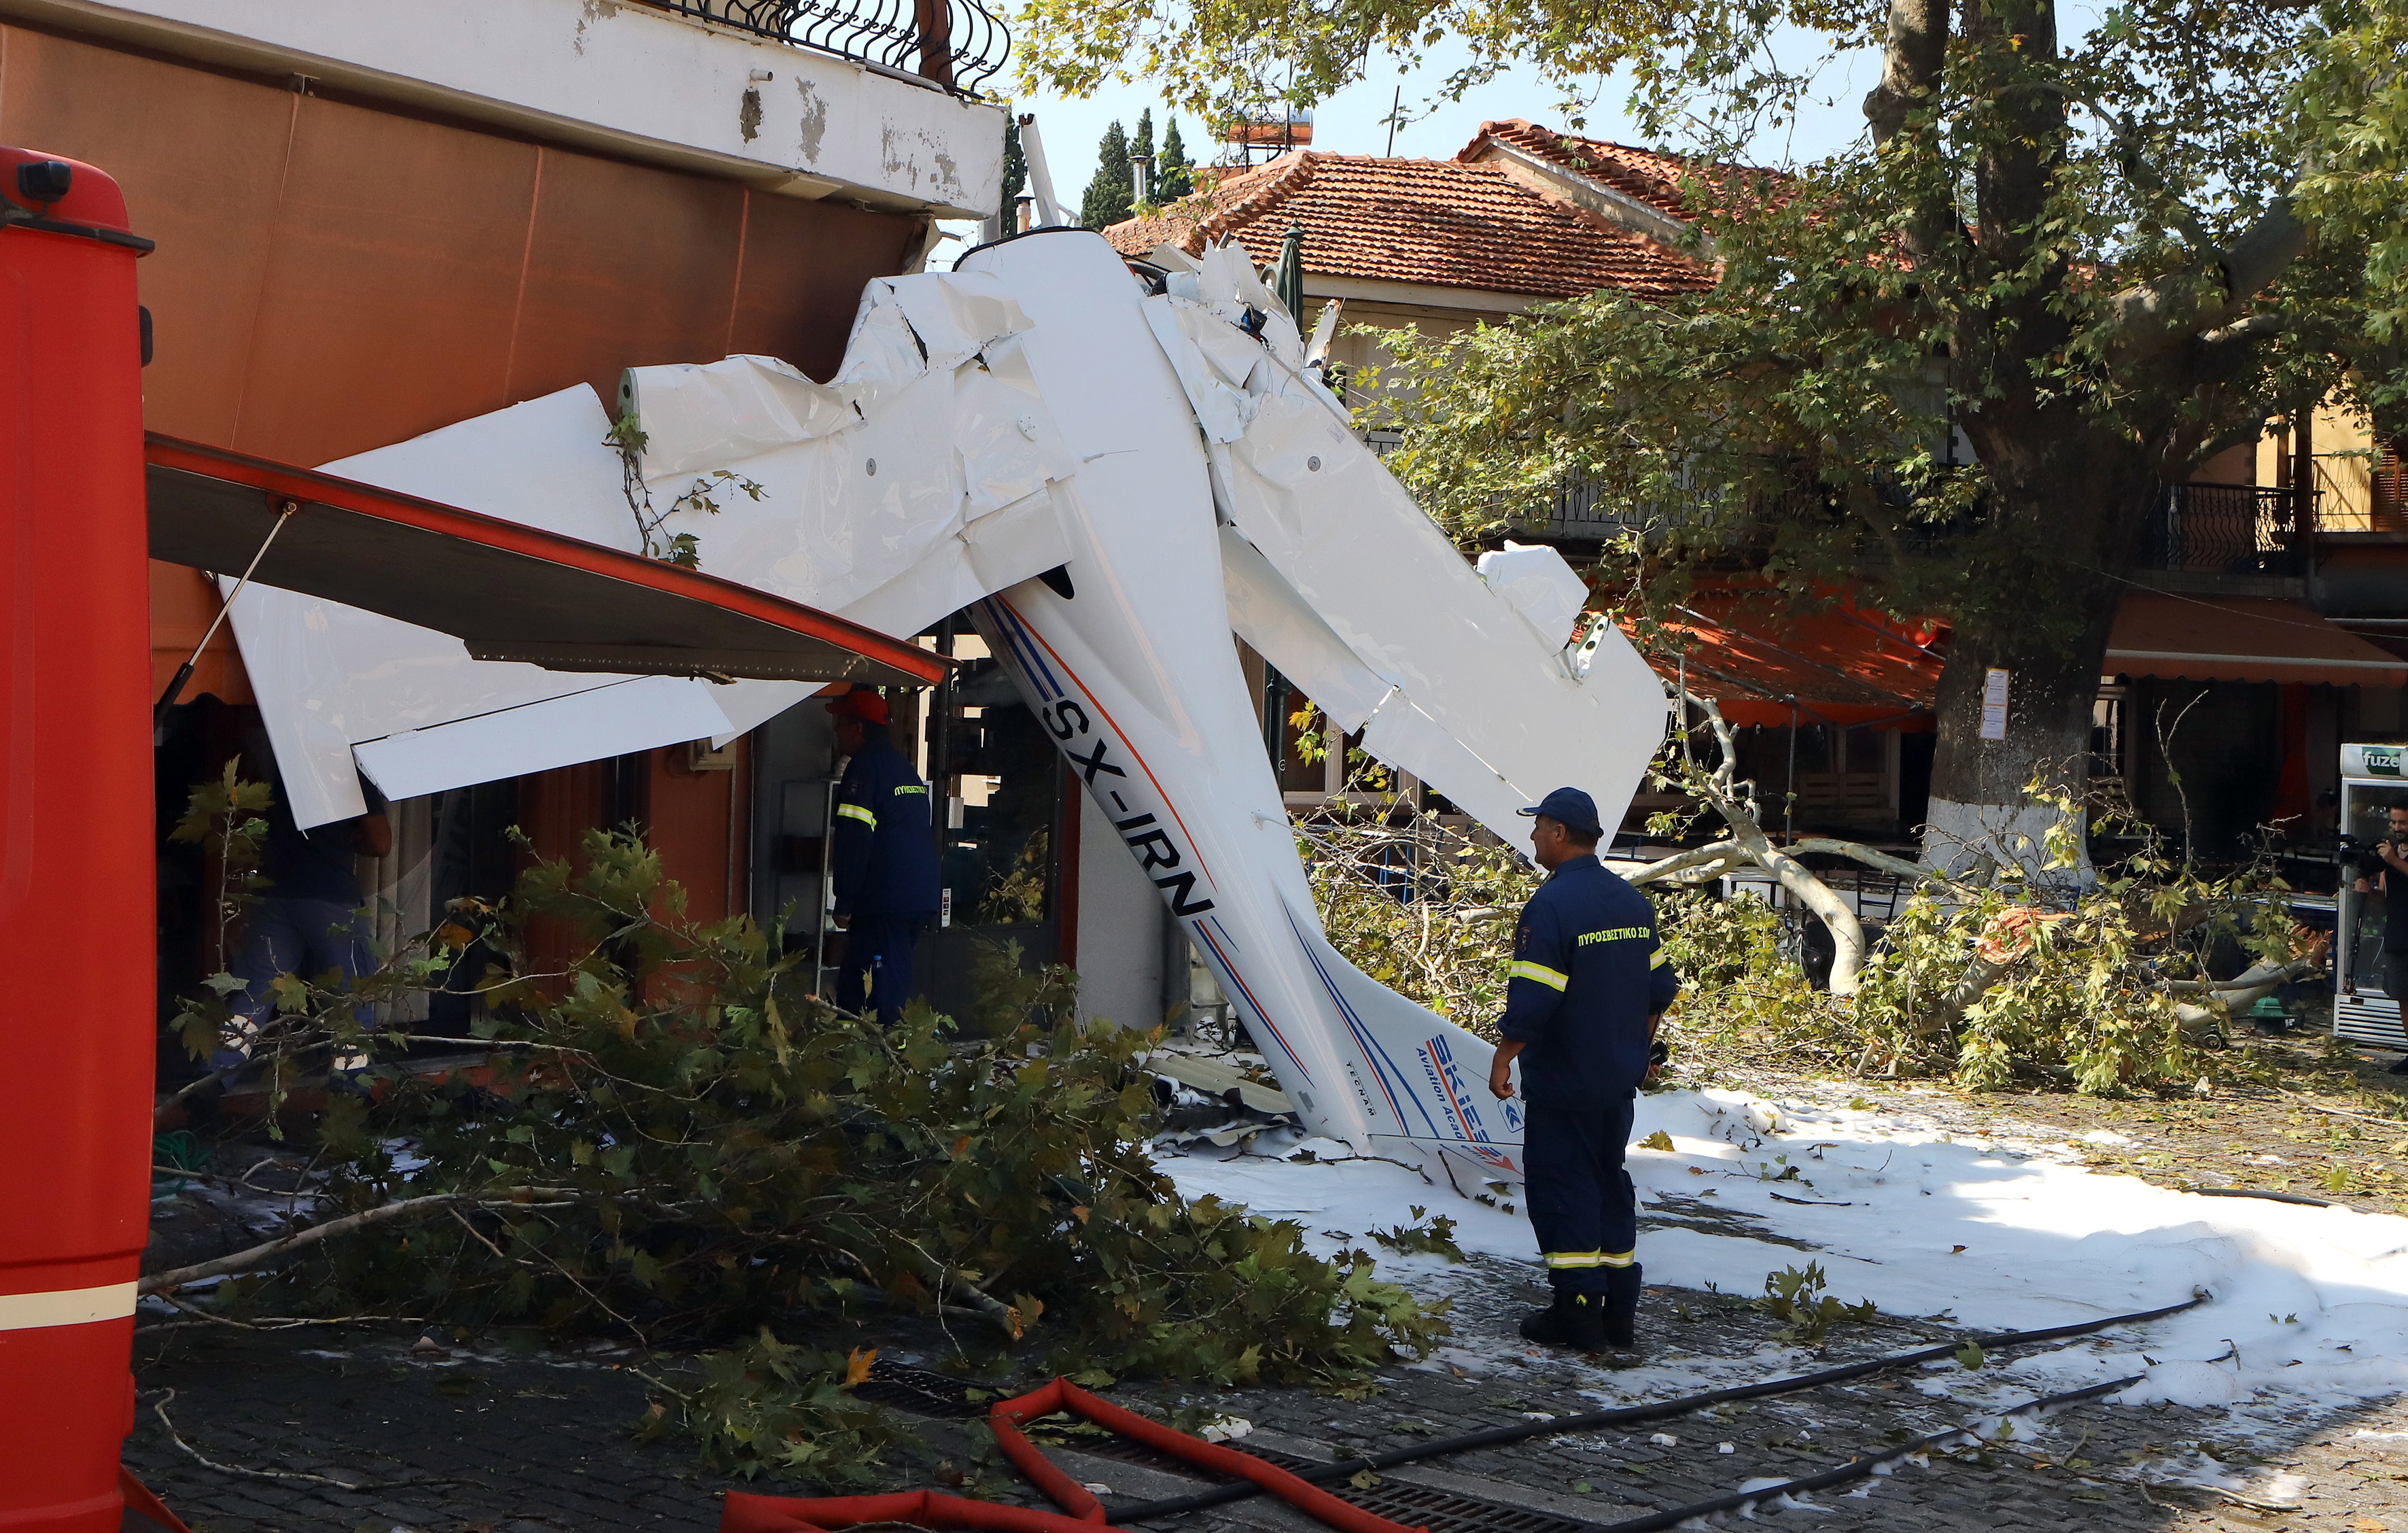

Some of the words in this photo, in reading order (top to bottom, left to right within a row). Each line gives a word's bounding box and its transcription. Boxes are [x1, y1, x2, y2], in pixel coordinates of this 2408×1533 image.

[2362, 751, 2400, 768] fuze
[1043, 700, 1215, 917] SX-IRN
[1577, 927, 1637, 946] ΠΥΡΟΣΒΕΣΤΙΚΟ
[1346, 1062, 1375, 1116] TECNAM
[1416, 1048, 1446, 1102] Aviation
